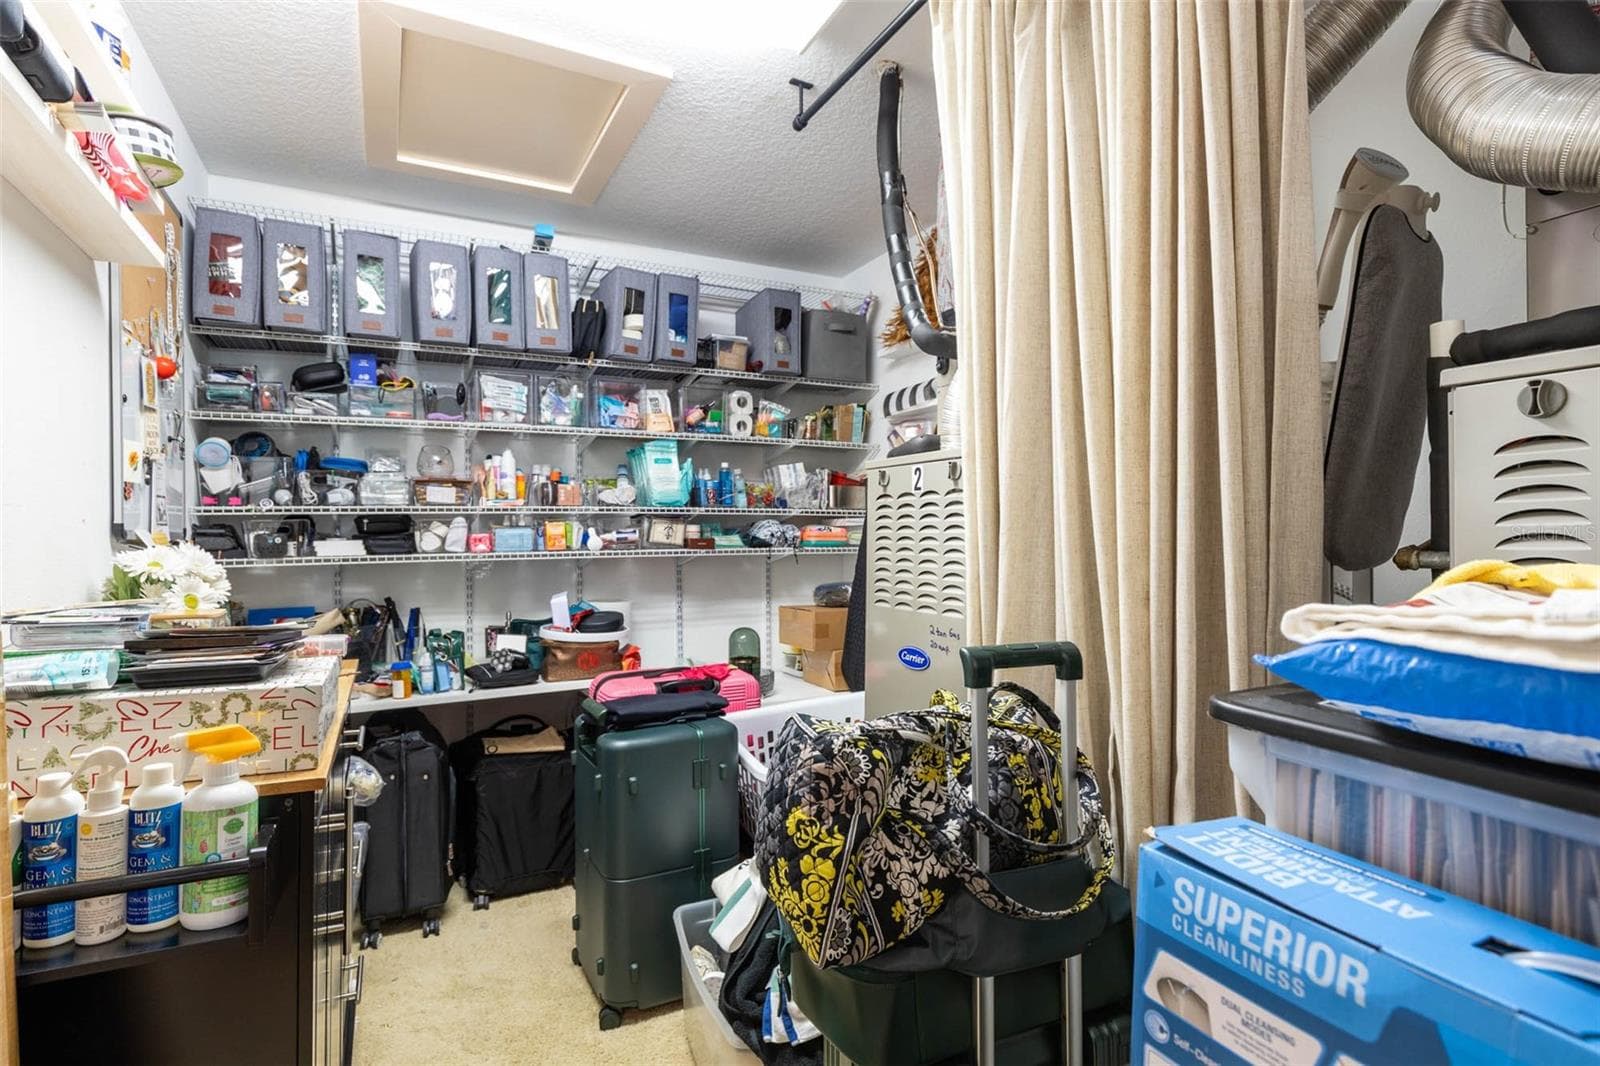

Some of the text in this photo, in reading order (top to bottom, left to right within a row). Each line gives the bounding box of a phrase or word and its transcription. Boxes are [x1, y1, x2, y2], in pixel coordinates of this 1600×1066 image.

[913, 467, 922, 491] 2
[929, 624, 936, 636] 2
[900, 650, 926, 664] Carrier
[134, 810, 162, 828] BLITZ
[30, 821, 62, 841] BLITZ
[129, 853, 171, 868] GEM &
[1176, 834, 1307, 889] BIDET
[25, 864, 73, 882] GEM &
[1203, 829, 1434, 919] ATTACHMENT
[1171, 876, 1369, 1008] SUPERIOR
[1171, 913, 1306, 999] CLEANLINESS
